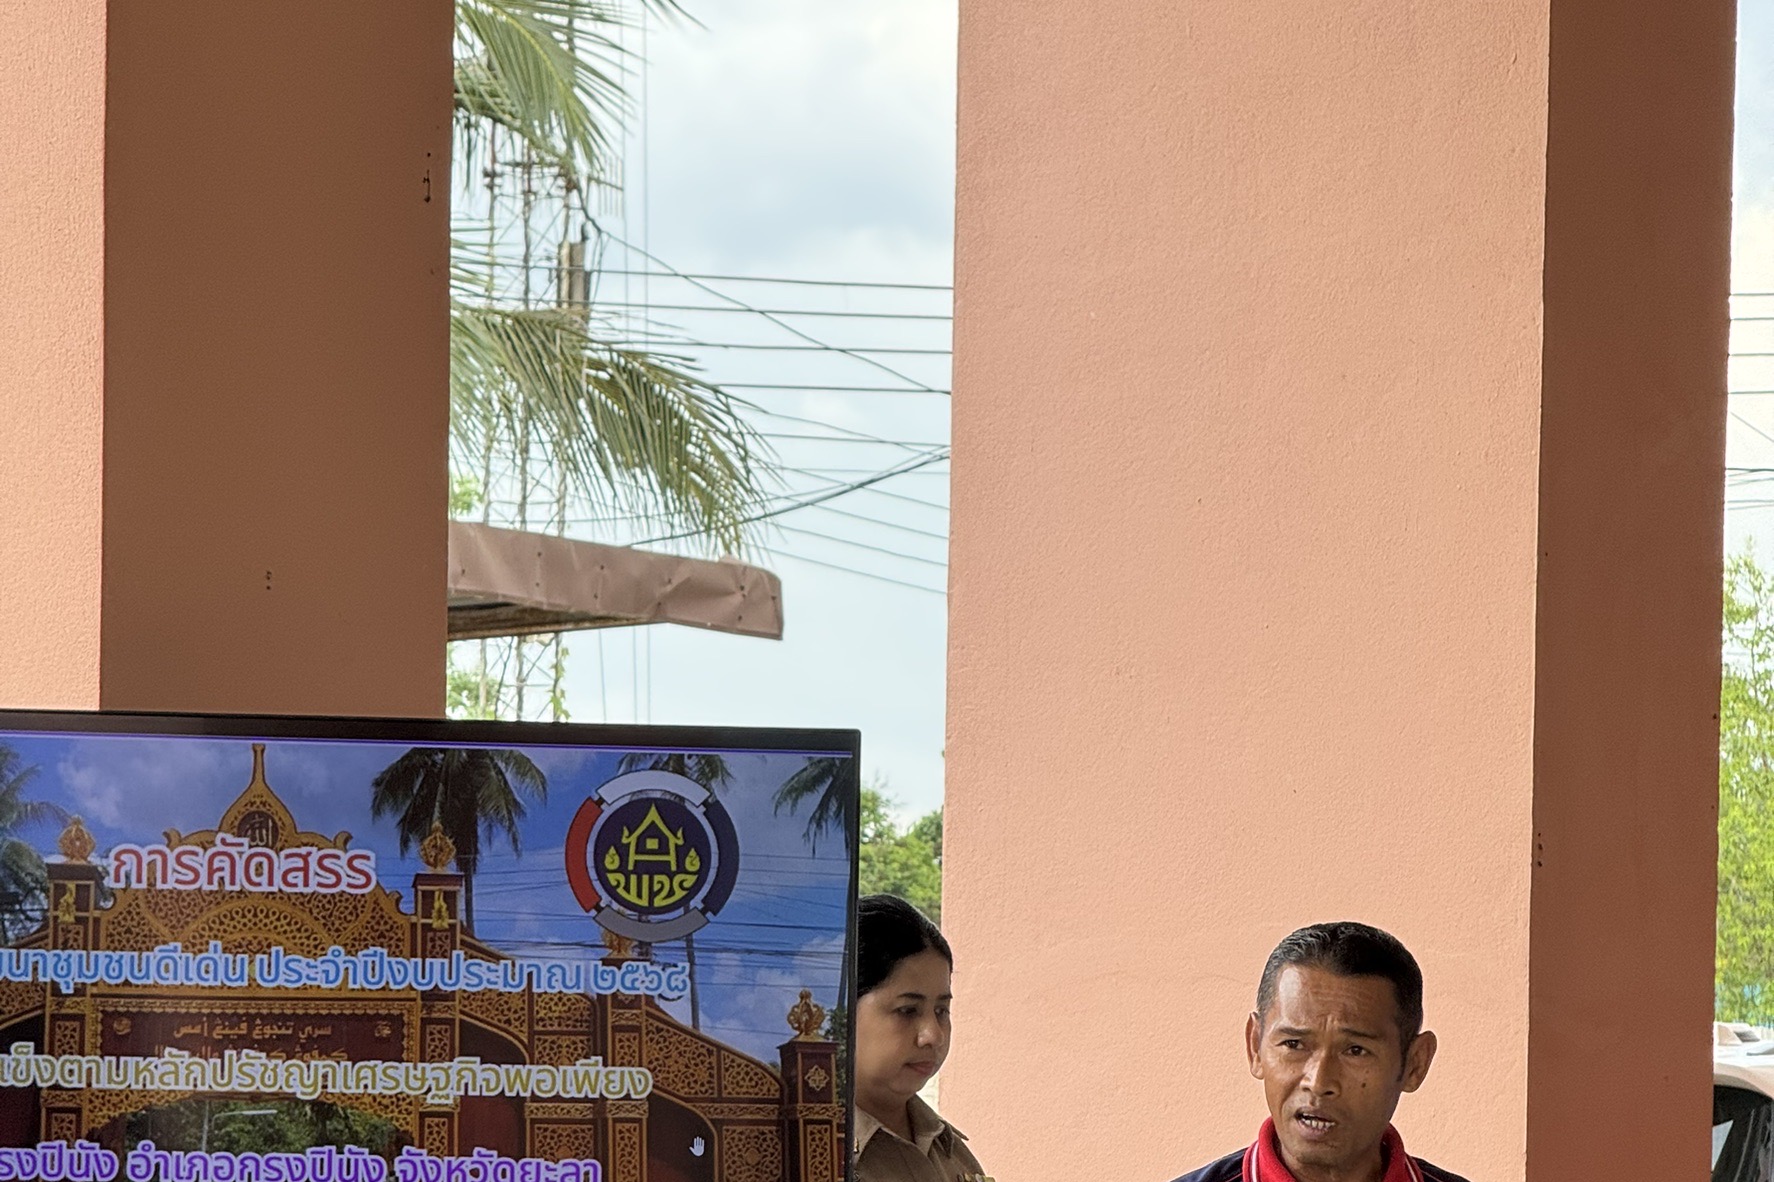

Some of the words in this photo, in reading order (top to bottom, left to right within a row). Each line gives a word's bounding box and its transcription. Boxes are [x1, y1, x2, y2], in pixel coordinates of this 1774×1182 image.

[111, 835, 375, 892] การคัดสรร
[0, 943, 246, 991] นาชุมชนดีเด่น
[258, 946, 584, 992] ประจำปีงบประมาณ
[593, 961, 690, 994] ๒๕๖๘
